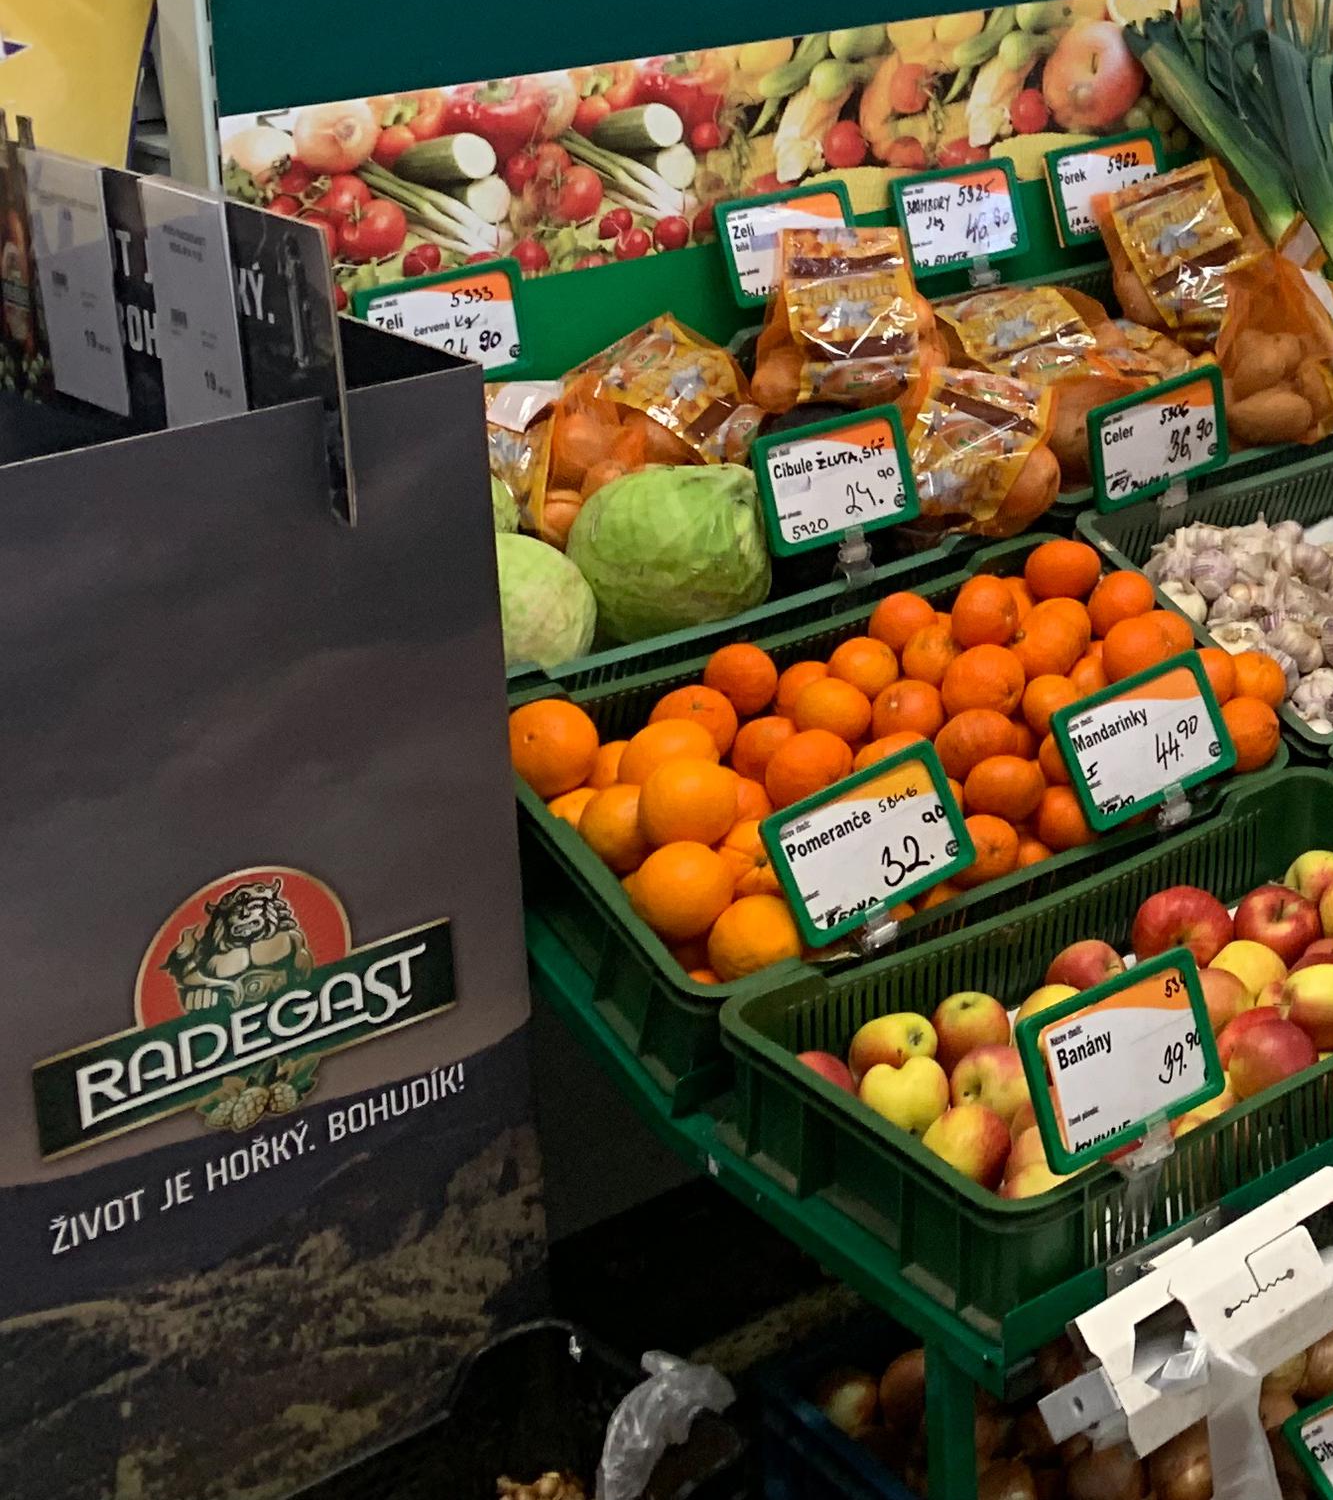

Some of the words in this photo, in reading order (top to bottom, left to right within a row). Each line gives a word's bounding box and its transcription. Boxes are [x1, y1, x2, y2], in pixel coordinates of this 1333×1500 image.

[1104, 425, 1134, 446] Celer
[773, 457, 814, 480] Cibule
[876, 466, 896, 481] 90
[792, 518, 829, 541] 5920
[1071, 708, 1148, 754] Mandarinky
[1177, 715, 1198, 740] 90
[785, 811, 872, 863] Pomeranče
[75, 943, 426, 1131] RADEGAST
[1056, 1031, 1112, 1071] Banány
[48, 1188, 144, 1256] ŽIVOT
[159, 1167, 195, 1213] JE
[206, 1119, 317, 1195] HOŘKÝ.
[328, 1062, 466, 1140] BOHUDÍK!
